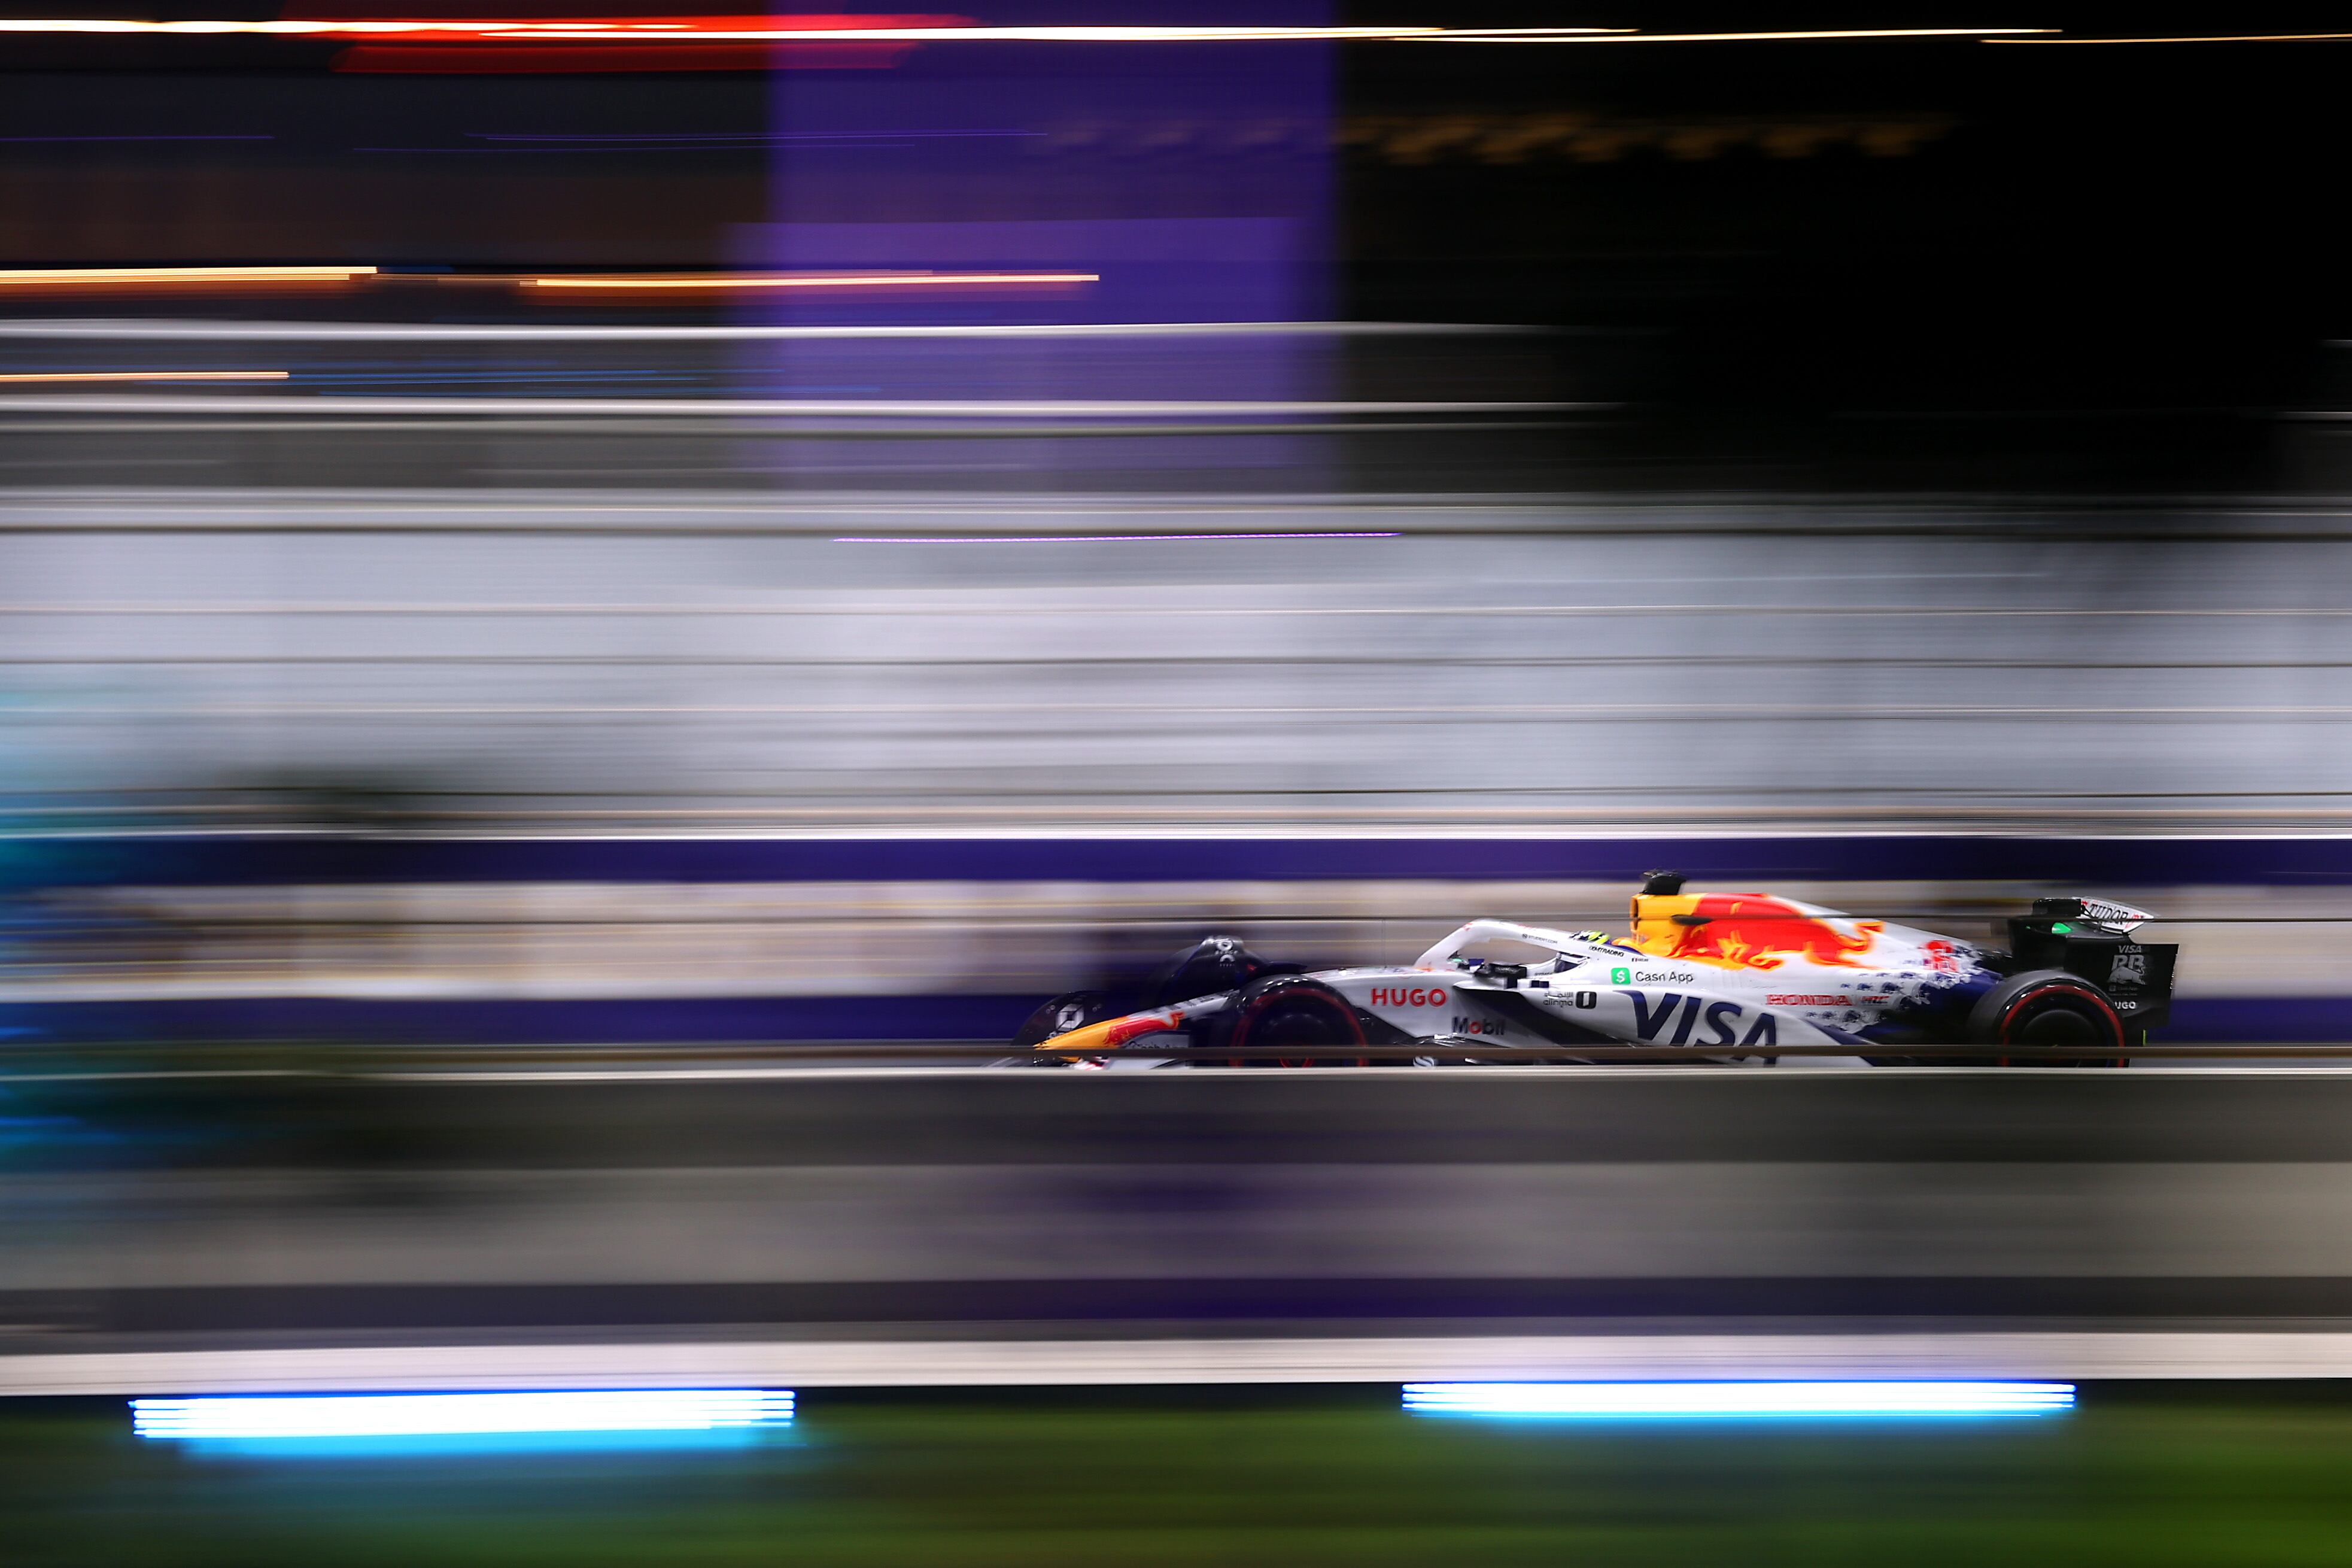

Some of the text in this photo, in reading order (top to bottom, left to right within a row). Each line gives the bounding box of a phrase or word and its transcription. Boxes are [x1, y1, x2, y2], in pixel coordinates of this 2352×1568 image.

[1669, 971, 1694, 984] App
[1371, 988, 1447, 1007] HUGO
[1766, 994, 1853, 1006] HONDA
[1452, 1016, 1505, 1035] Mobil
[1613, 990, 1776, 1066] VISA
